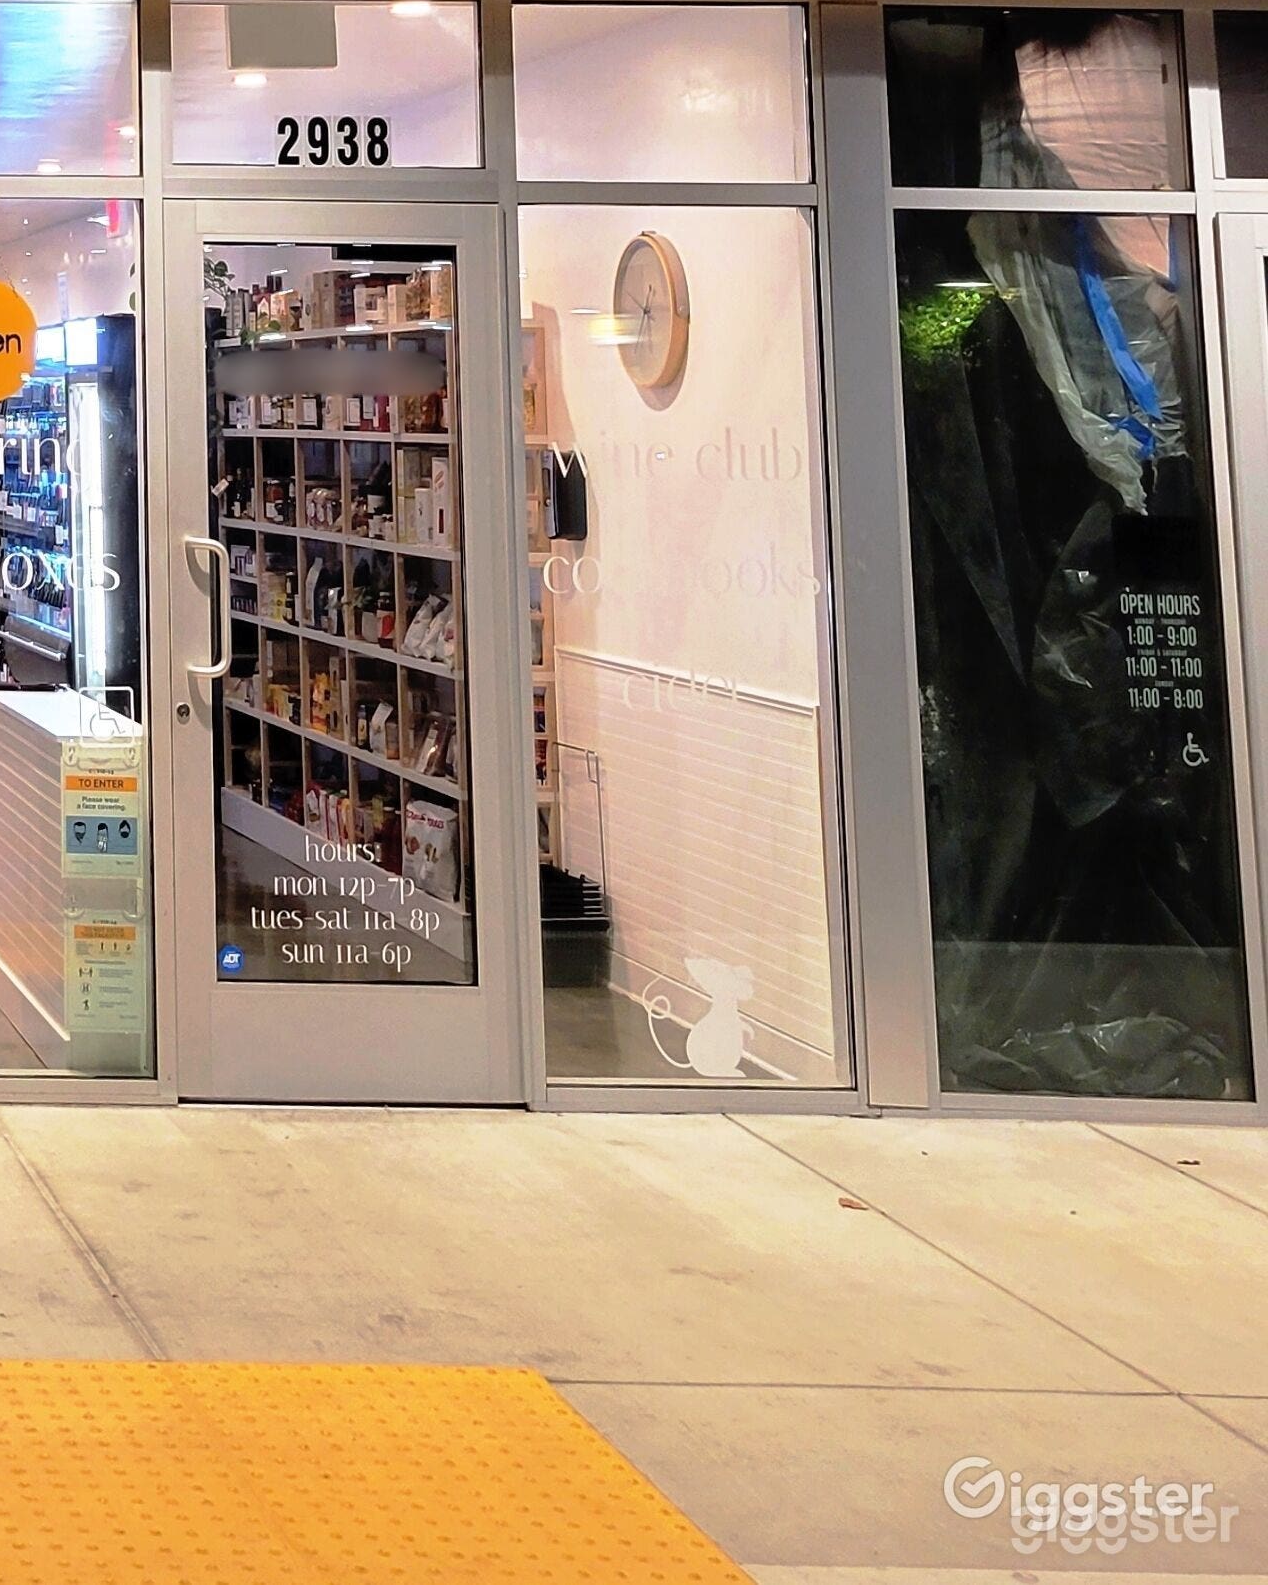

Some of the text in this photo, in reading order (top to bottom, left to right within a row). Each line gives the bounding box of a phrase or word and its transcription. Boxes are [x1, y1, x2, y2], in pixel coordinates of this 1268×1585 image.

[277, 116, 389, 166] 2938
[695, 426, 802, 482] club
[1120, 593, 1201, 616] OPEN HOURS
[1127, 625, 1154, 646] 1:00
[1167, 626, 1198, 647] 9:00
[1125, 656, 1158, 677] 11:00
[1170, 657, 1203, 678] 11:00
[1128, 687, 1161, 709] 11:00
[1173, 688, 1204, 709] 8:00
[78, 778, 124, 789] TO ENTER
[305, 835, 381, 863] hours:
[273, 875, 327, 897] mon
[251, 906, 351, 931] tues-sat
[282, 942, 324, 964] sun
